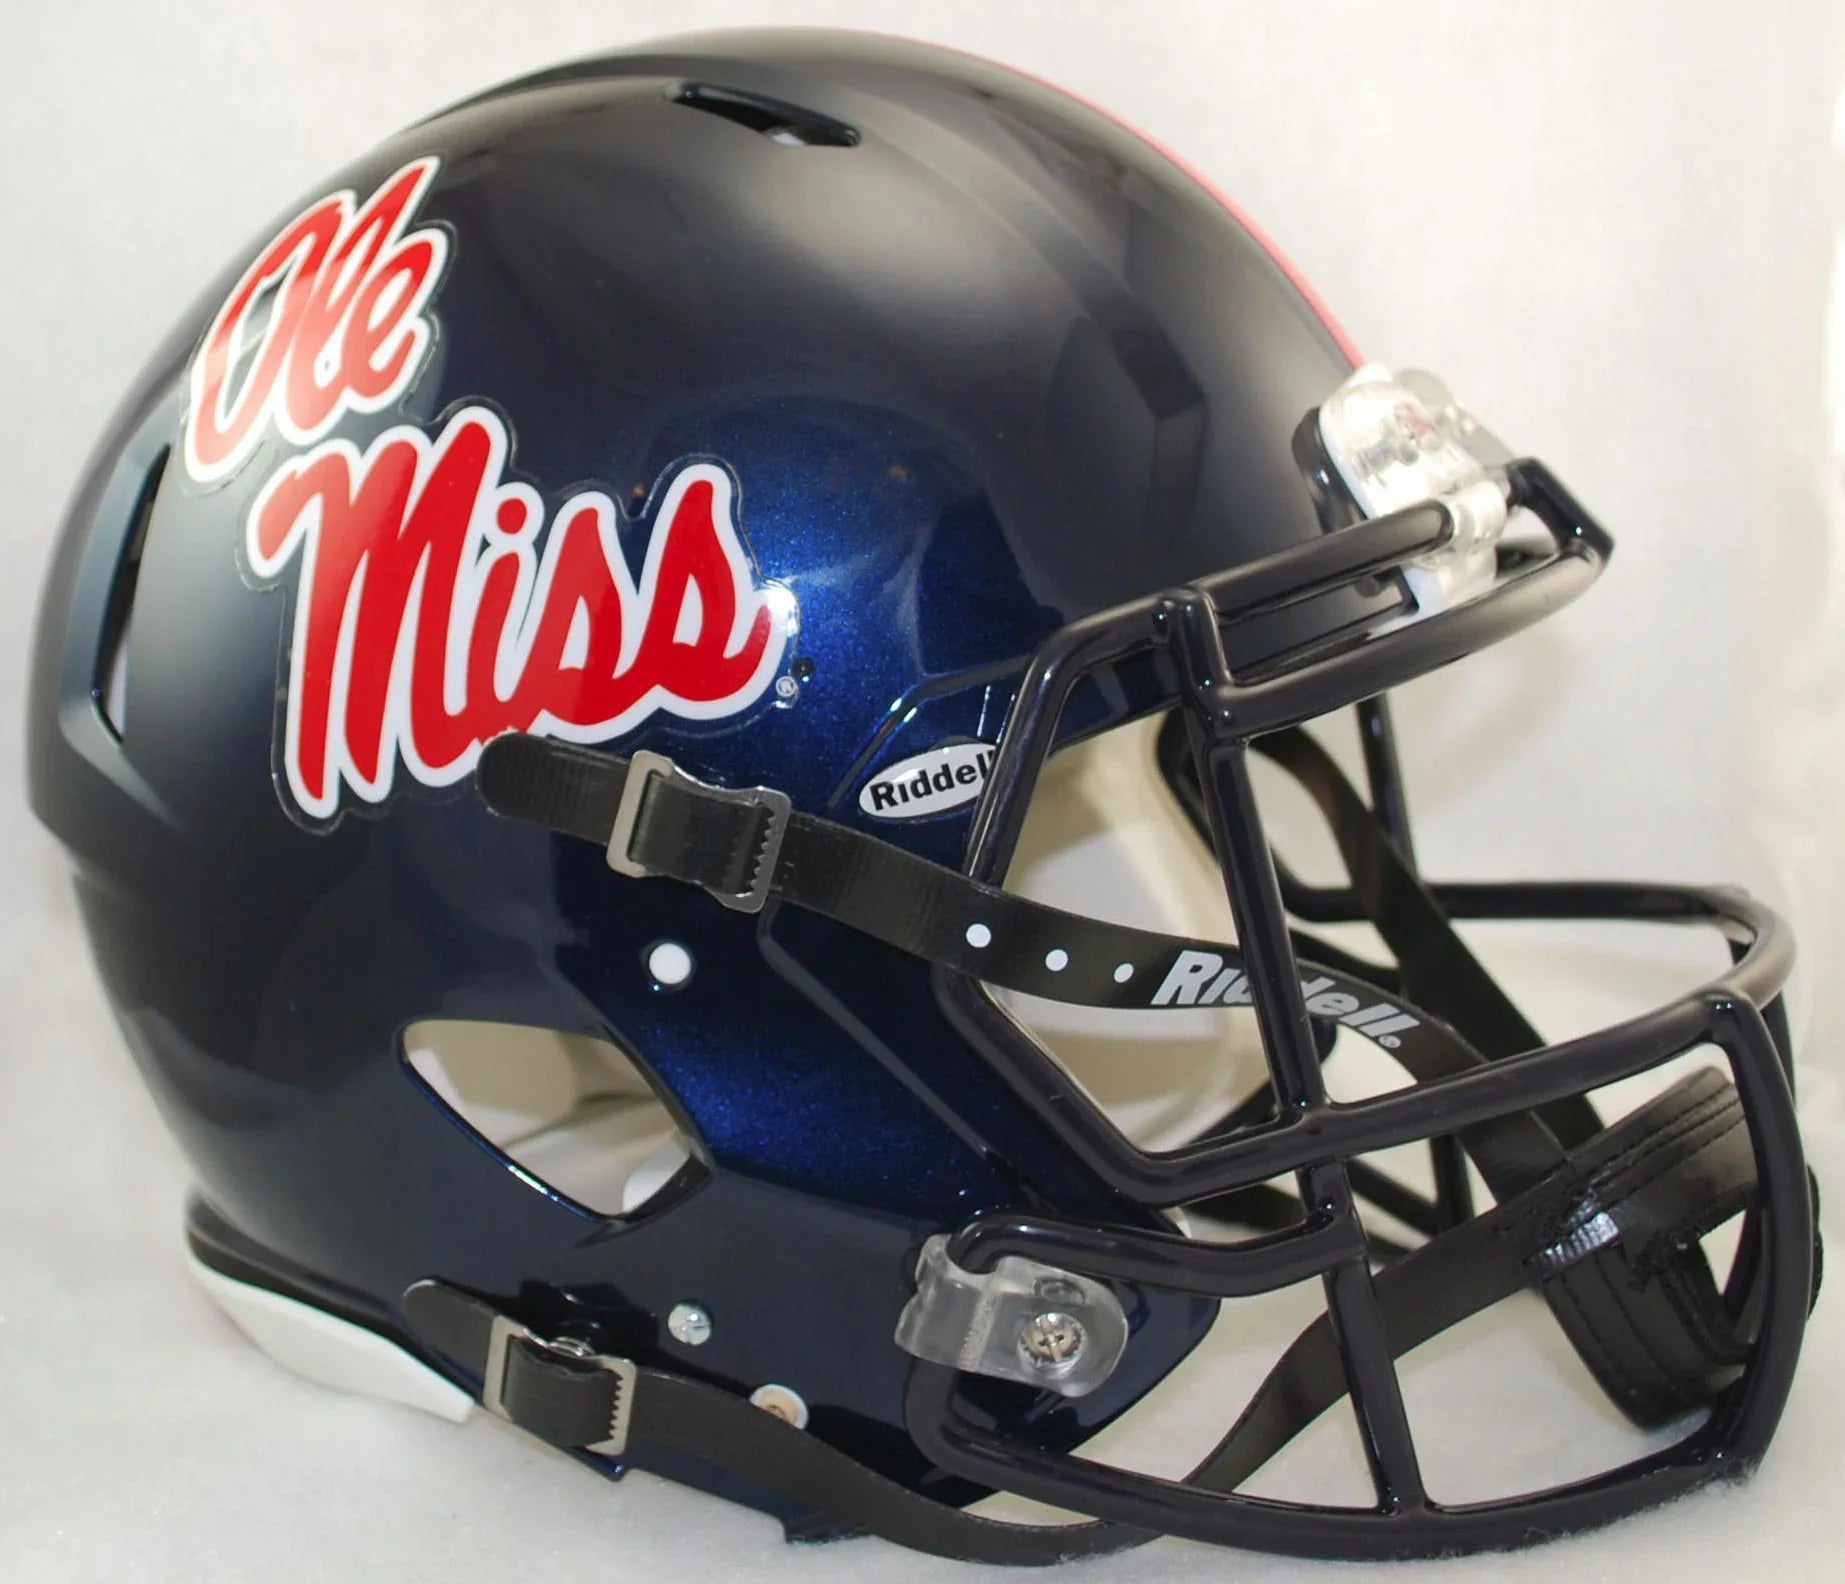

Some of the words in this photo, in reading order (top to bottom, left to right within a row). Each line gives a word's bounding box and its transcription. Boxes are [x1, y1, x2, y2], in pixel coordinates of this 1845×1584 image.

[185, 156, 449, 481] Ole
[246, 406, 795, 818] Miss
[869, 750, 996, 811] Riddel
